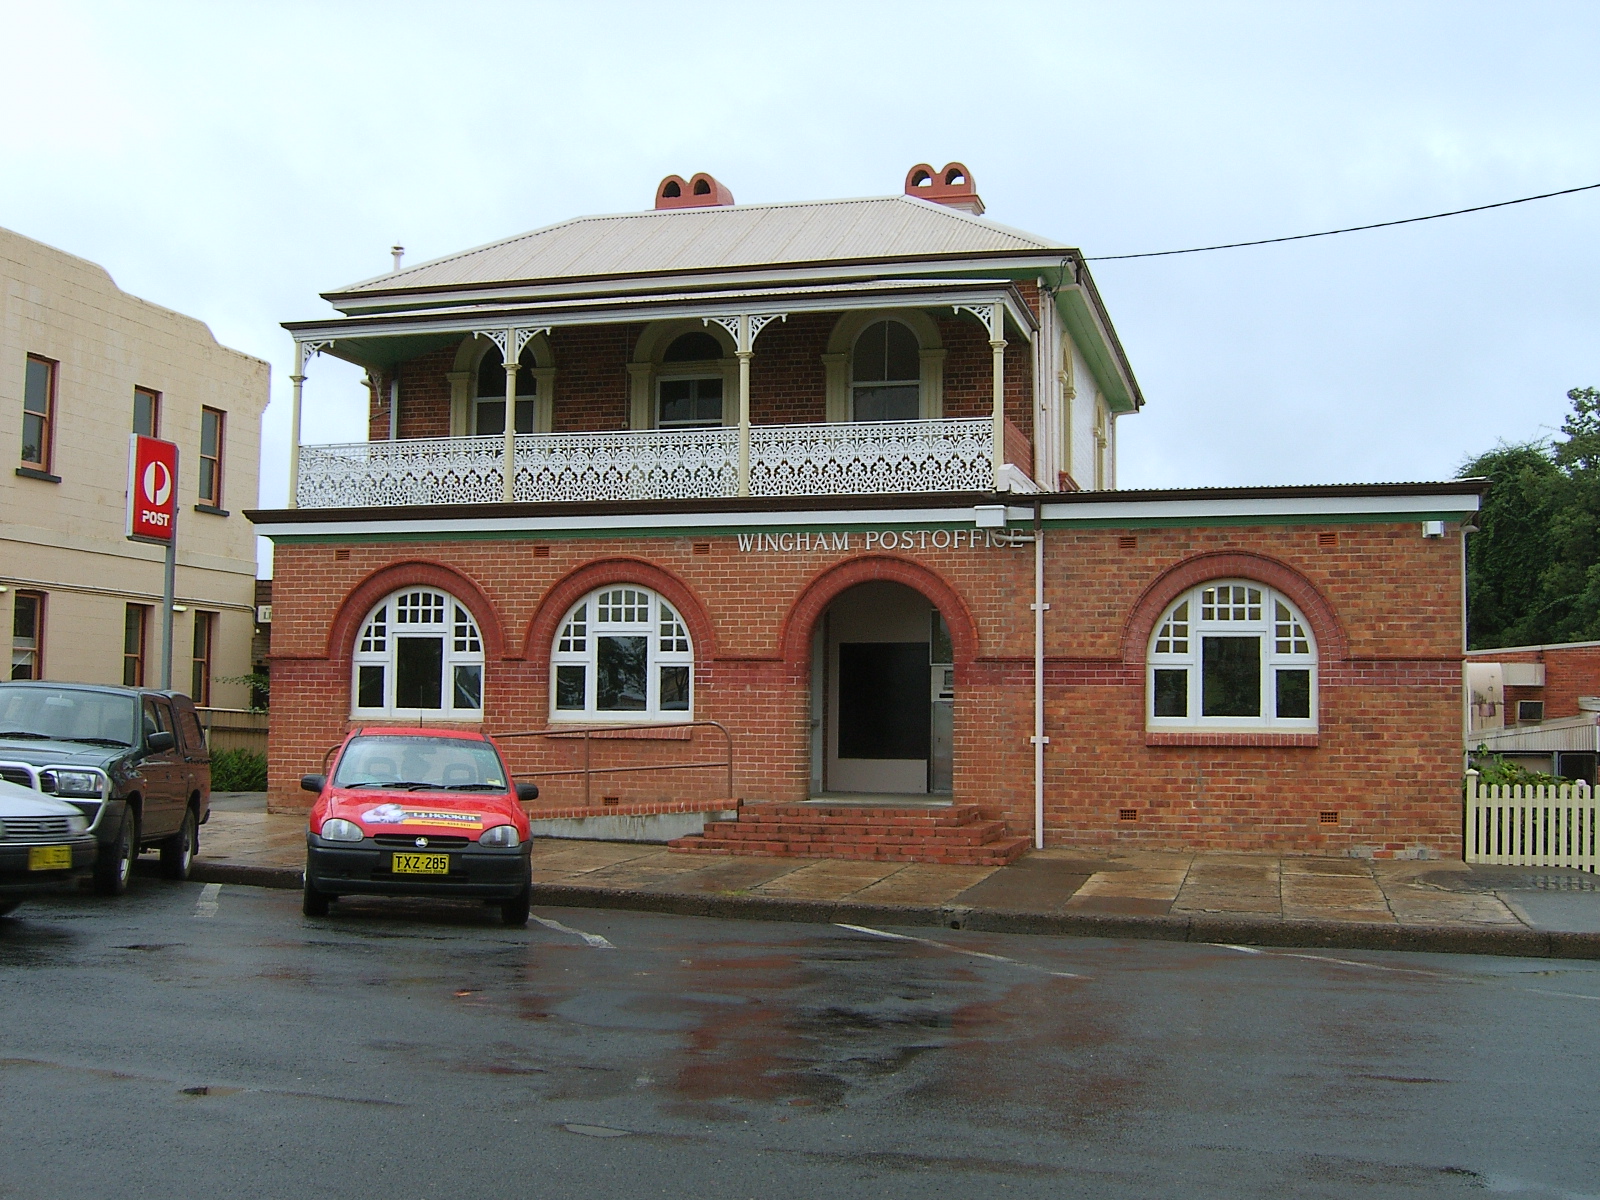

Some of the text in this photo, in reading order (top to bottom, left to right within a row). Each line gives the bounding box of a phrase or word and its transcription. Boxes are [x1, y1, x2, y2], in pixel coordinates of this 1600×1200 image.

[142, 510, 170, 526] POST
[737, 532, 849, 552] WINGHAM
[429, 813, 476, 821] HOOKER
